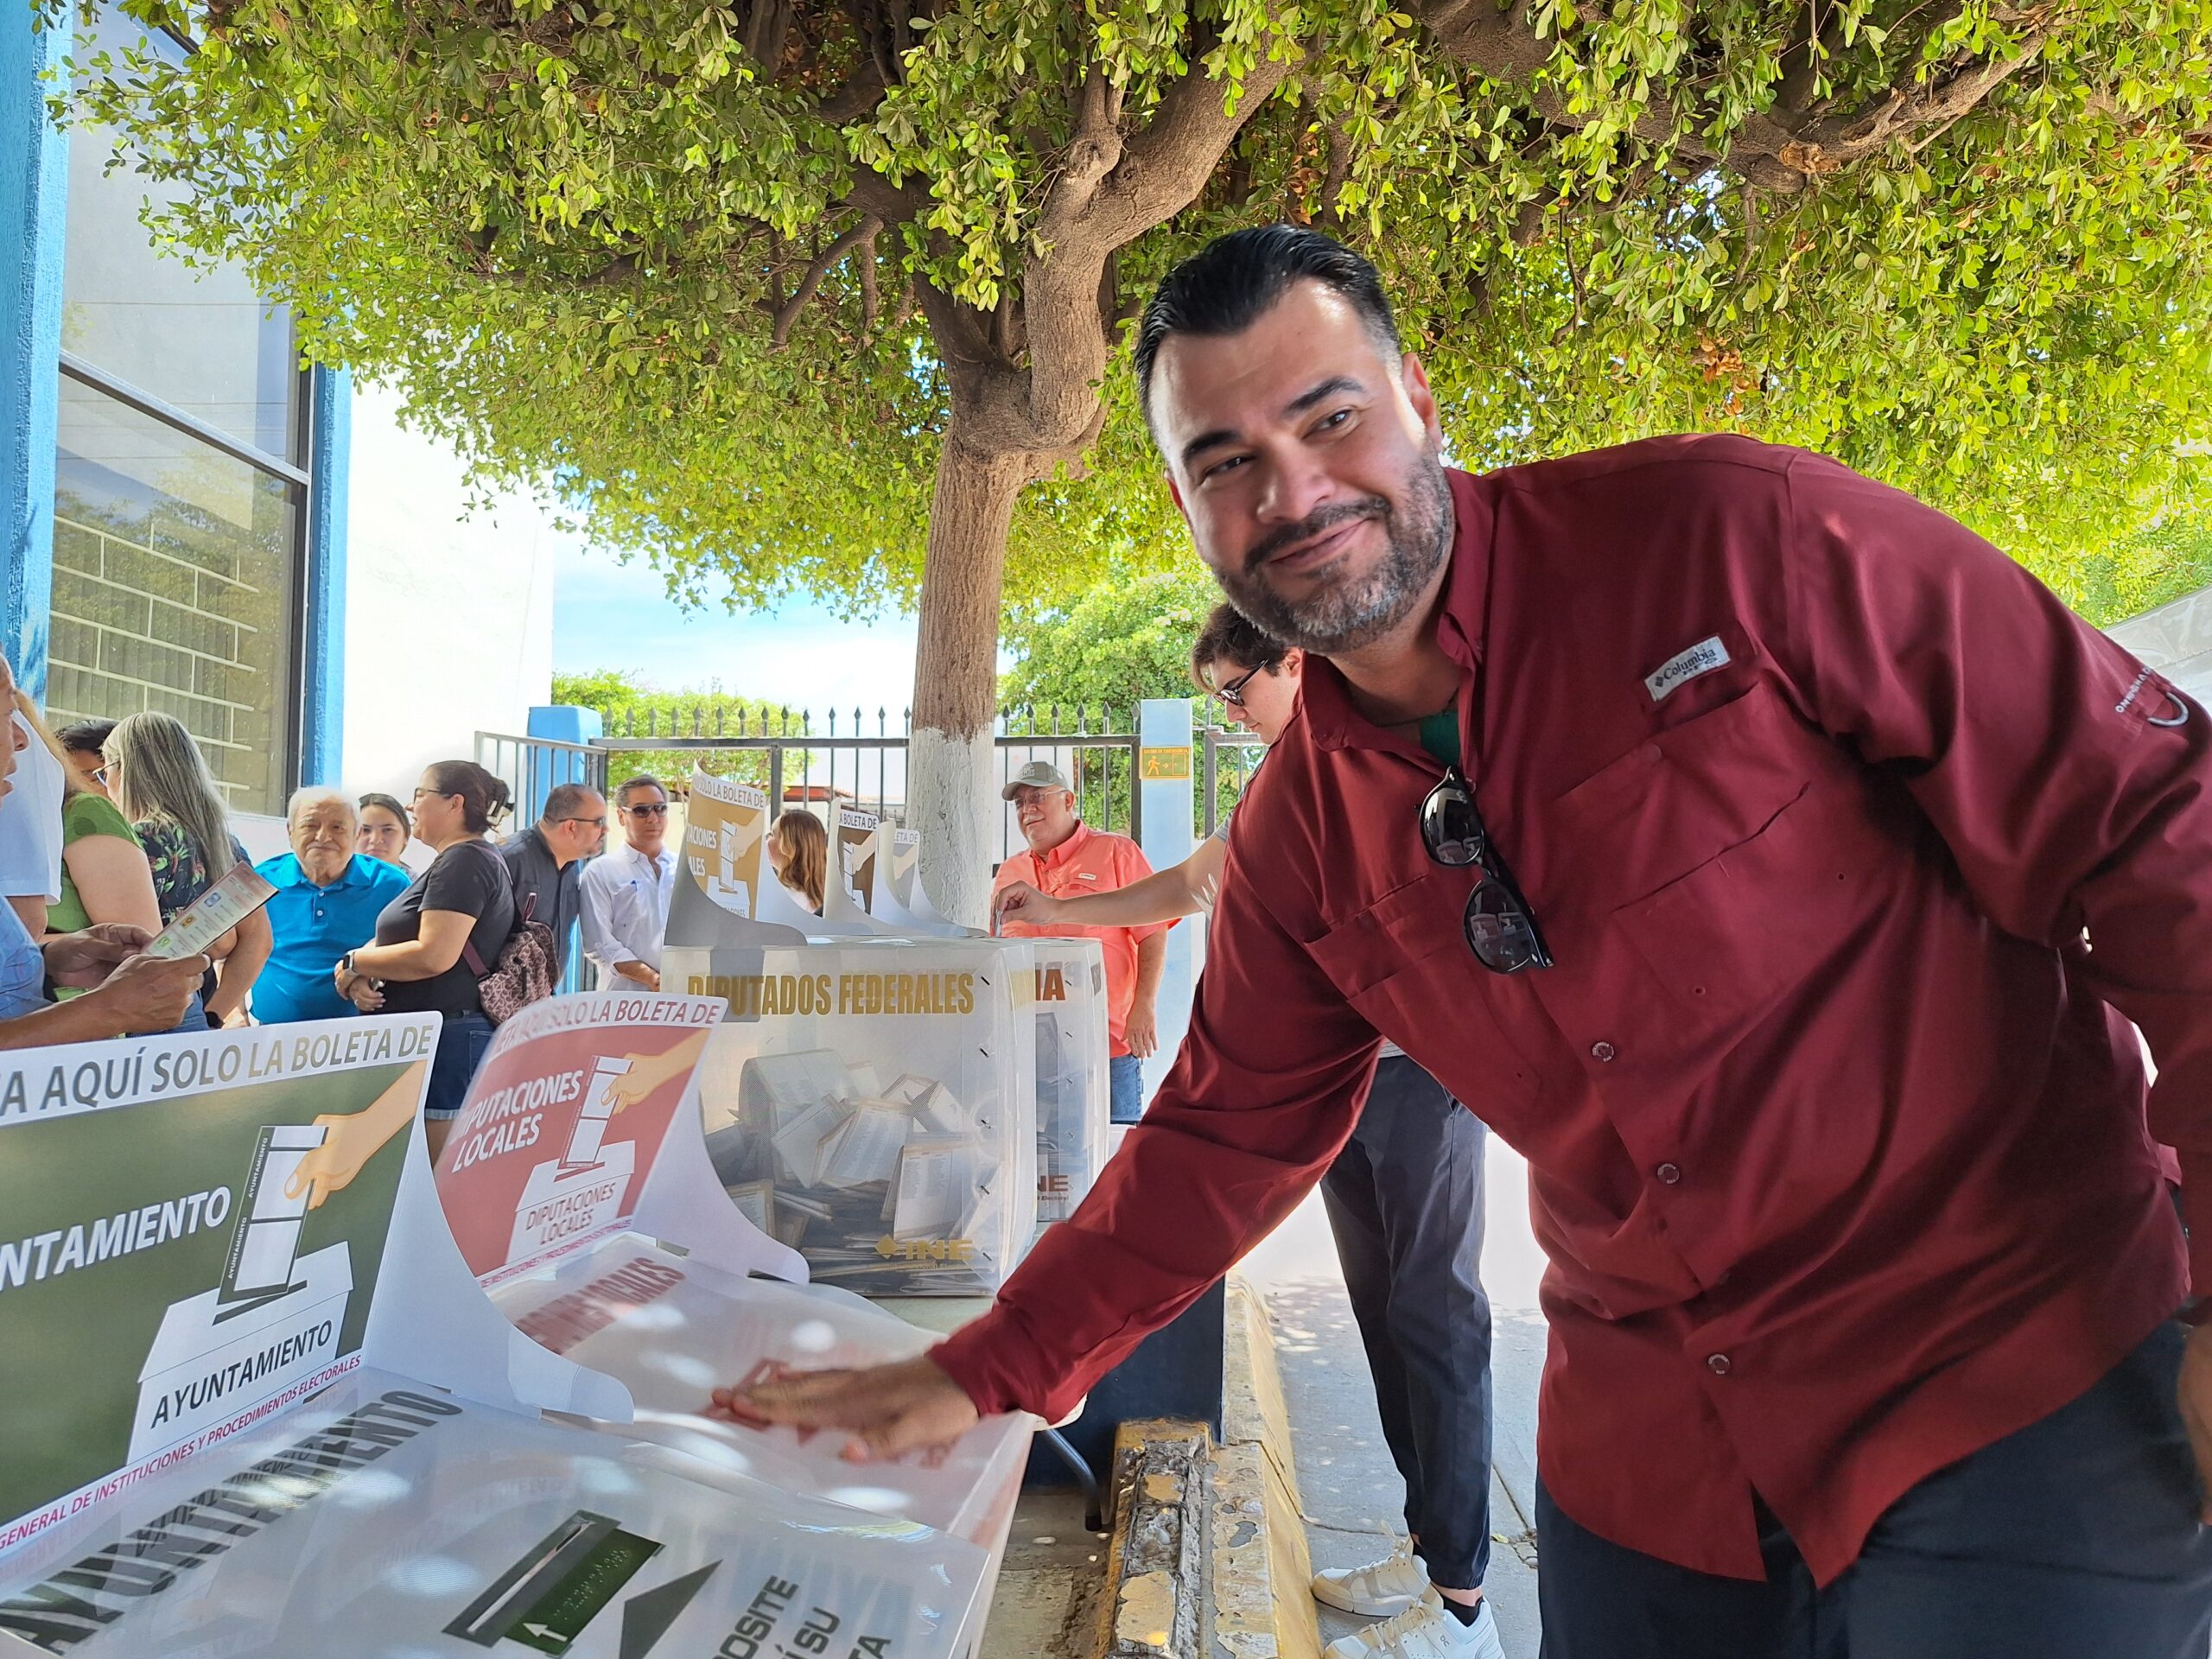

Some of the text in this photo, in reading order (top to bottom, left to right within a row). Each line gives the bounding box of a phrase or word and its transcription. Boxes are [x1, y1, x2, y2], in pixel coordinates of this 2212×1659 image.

[1663, 649, 1716, 679] Columbia
[723, 785, 753, 806] BOLETA
[754, 793, 764, 808] DE
[843, 813, 866, 829] BOLETA
[868, 817, 877, 830] DE
[909, 833, 918, 843] DE
[590, 1001, 611, 1023] LA
[614, 1000, 688, 1023] BOLETA
[690, 1003, 721, 1025] DE
[838, 973, 974, 1015] FEDERALES
[40, 1046, 147, 1110] AQUÍ
[151, 1045, 241, 1093] SOLO
[248, 1039, 283, 1078] LA
[291, 1028, 391, 1072] BOLETA
[398, 1025, 434, 1058] DE
[248, 1137, 269, 1198] AYUNTAMIENTO
[452, 1113, 544, 1174] LOCALES
[525, 1182, 616, 1231] DIPUTACIONES
[539, 1208, 594, 1246] LOCALES
[227, 1217, 248, 1280] AYUNTAMIENTO
[906, 1239, 974, 1260] INE
[151, 1319, 333, 1430] AYUNTAMIENTO
[0, 1354, 361, 1550] GENERAL DE INSTITUCIONES Y PROCEDIMIENTOS ELECTORALES
[712, 1575, 799, 1659] OSITE
[793, 1606, 841, 1655] SU
